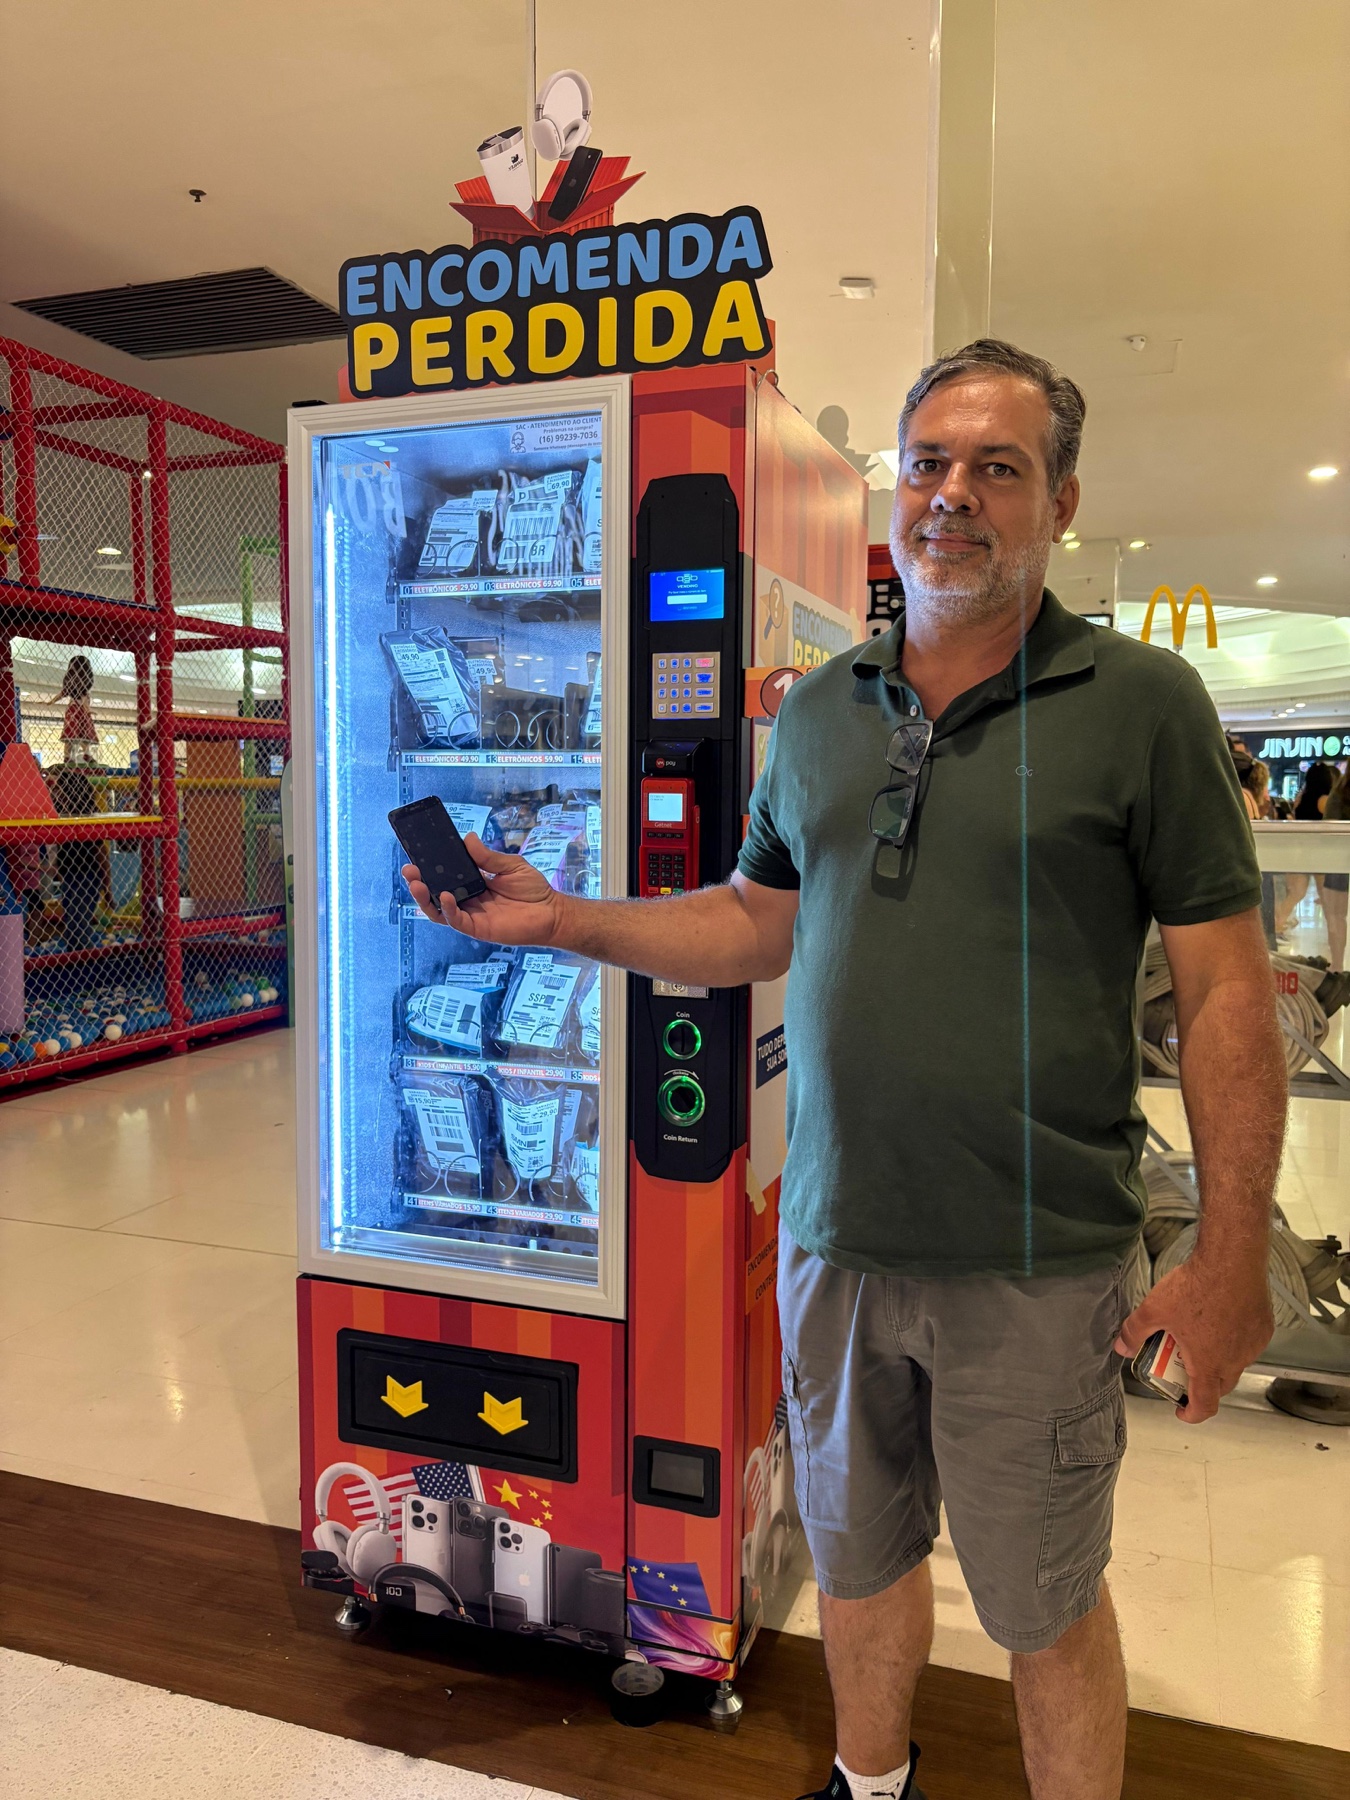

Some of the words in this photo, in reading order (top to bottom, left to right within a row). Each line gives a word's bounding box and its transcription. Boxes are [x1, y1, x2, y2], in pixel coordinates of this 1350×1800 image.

[346, 215, 763, 316] ENCOMENDA
[353, 280, 765, 392] PERDIDA
[530, 419, 571, 429] ATENDIMENTO
[539, 435, 553, 445] (16)
[555, 431, 598, 442] 99239-7036
[551, 480, 570, 489] 69,90
[485, 582, 495, 591] 03
[495, 580, 541, 590] ELETRÔNICOS
[543, 580, 562, 588] 69,90
[571, 578, 582, 587] 05
[404, 586, 413, 594] 01
[414, 584, 458, 594] ELETRÔNICOS
[460, 583, 478, 591] 29,90
[402, 653, 419, 661] 49,90
[1258, 736, 1324, 759] JINJIN
[415, 754, 459, 763] ELETRÔNICOS
[460, 755, 478, 763] 49,90
[487, 755, 497, 763] 13
[497, 754, 543, 763] ELETRÔNICOS
[544, 755, 563, 763] 59,90
[572, 755, 583, 764] 15
[531, 963, 551, 971] 29,90
[528, 993, 546, 1002] SSP
[757, 1040, 774, 1061] TUDO
[406, 1059, 415, 1067] 31
[463, 1063, 480, 1071] 15,90
[766, 1053, 778, 1072] SUA
[545, 1069, 564, 1077] 29,90
[572, 1071, 583, 1080] 35
[539, 1108, 557, 1118] 29,90
[663, 1133, 677, 1141] Coin
[677, 1135, 698, 1143] Return
[408, 1197, 417, 1205] 41
[463, 1203, 481, 1212] 15,90
[486, 1206, 498, 1214] 43
[515, 1210, 544, 1219] VARIADOS
[545, 1212, 563, 1220] 29,90
[571, 1215, 582, 1223] 45
